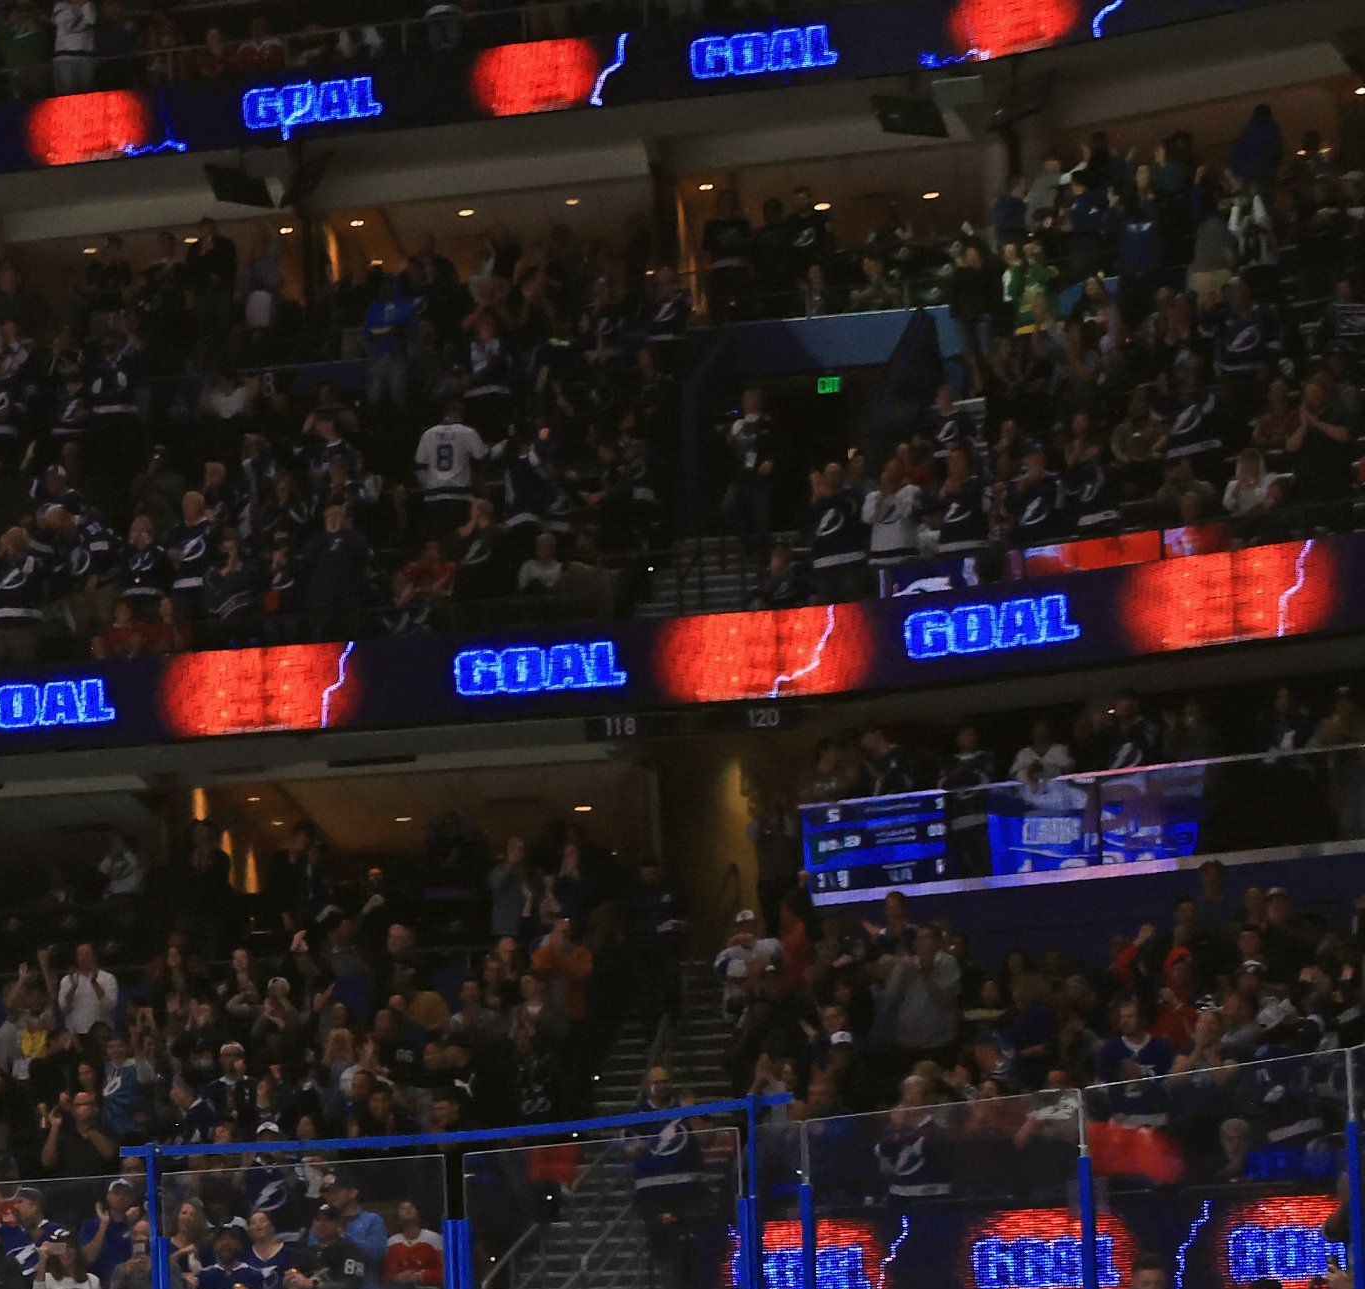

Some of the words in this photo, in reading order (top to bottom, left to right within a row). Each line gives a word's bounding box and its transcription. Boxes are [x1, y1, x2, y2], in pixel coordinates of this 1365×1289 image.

[689, 25, 839, 79] GOAL
[243, 77, 382, 131] GOAL
[903, 593, 1080, 658] GOAL
[453, 640, 627, 698] GOAL
[606, 717, 637, 736] 118
[749, 708, 780, 728] 120
